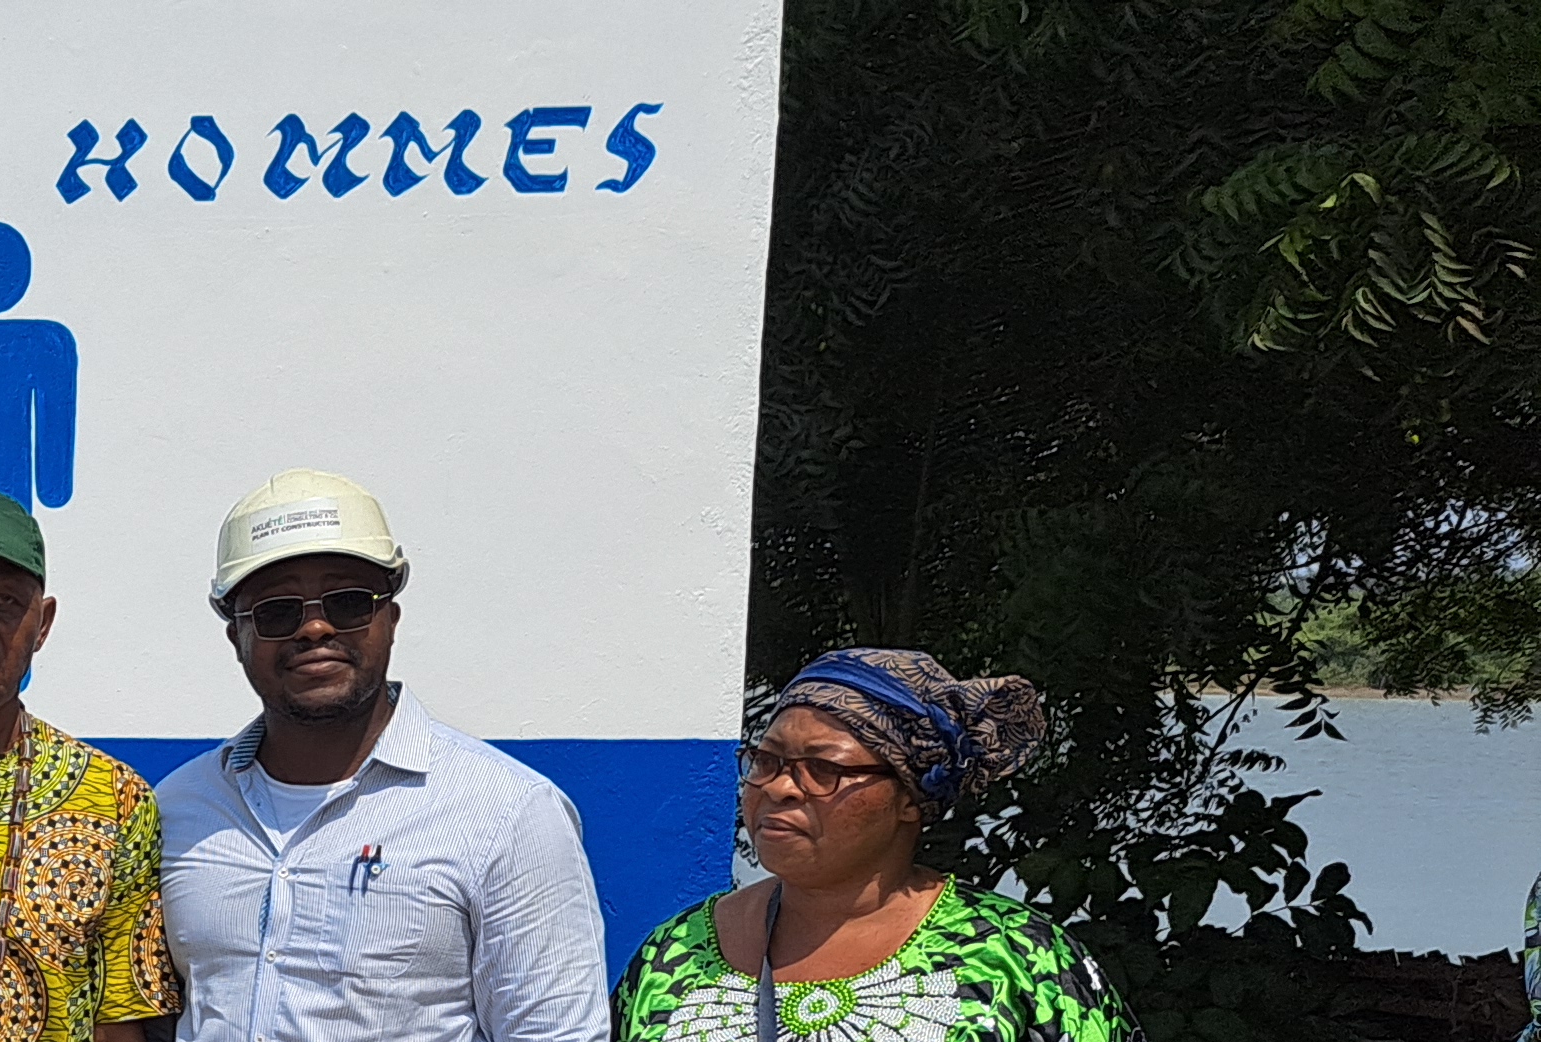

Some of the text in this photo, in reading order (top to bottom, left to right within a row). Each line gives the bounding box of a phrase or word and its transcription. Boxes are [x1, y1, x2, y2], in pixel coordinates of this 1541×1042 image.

[55, 102, 665, 205] HOMMES
[271, 527, 280, 536] ET
[281, 520, 340, 533] CONSTRUCTION
